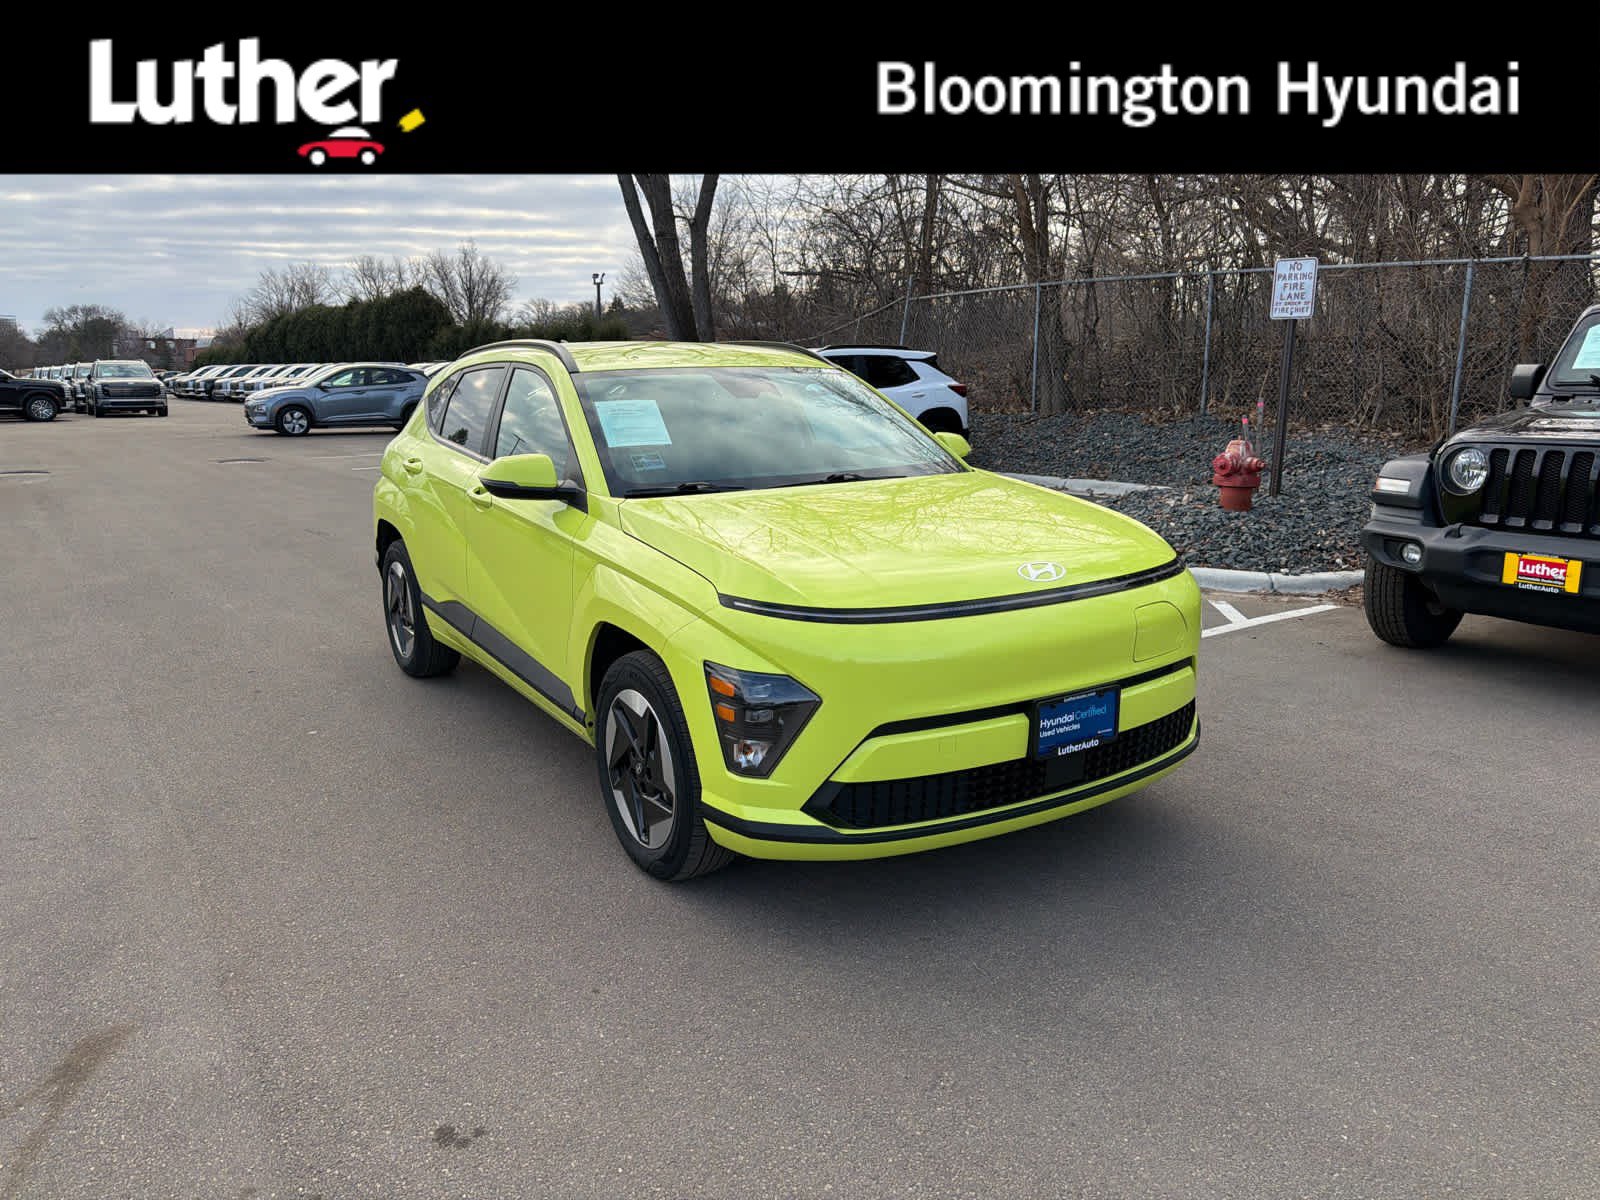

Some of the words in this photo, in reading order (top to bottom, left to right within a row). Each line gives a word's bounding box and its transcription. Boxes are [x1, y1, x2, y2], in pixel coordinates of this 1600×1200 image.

[1289, 262, 1303, 271] NO
[1277, 272, 1313, 281] PARKING
[1283, 282, 1305, 291] FIRE
[1280, 292, 1306, 301] LANE
[1274, 306, 1289, 314] FIRE
[1518, 560, 1566, 578] Luther
[1518, 582, 1559, 594] LutherAuto
[1040, 711, 1075, 729] Hyundai
[1075, 703, 1107, 721] Certified
[1040, 727, 1056, 738] Used
[1056, 723, 1081, 736] Vehicles
[1057, 739, 1100, 756] LutherAuto
